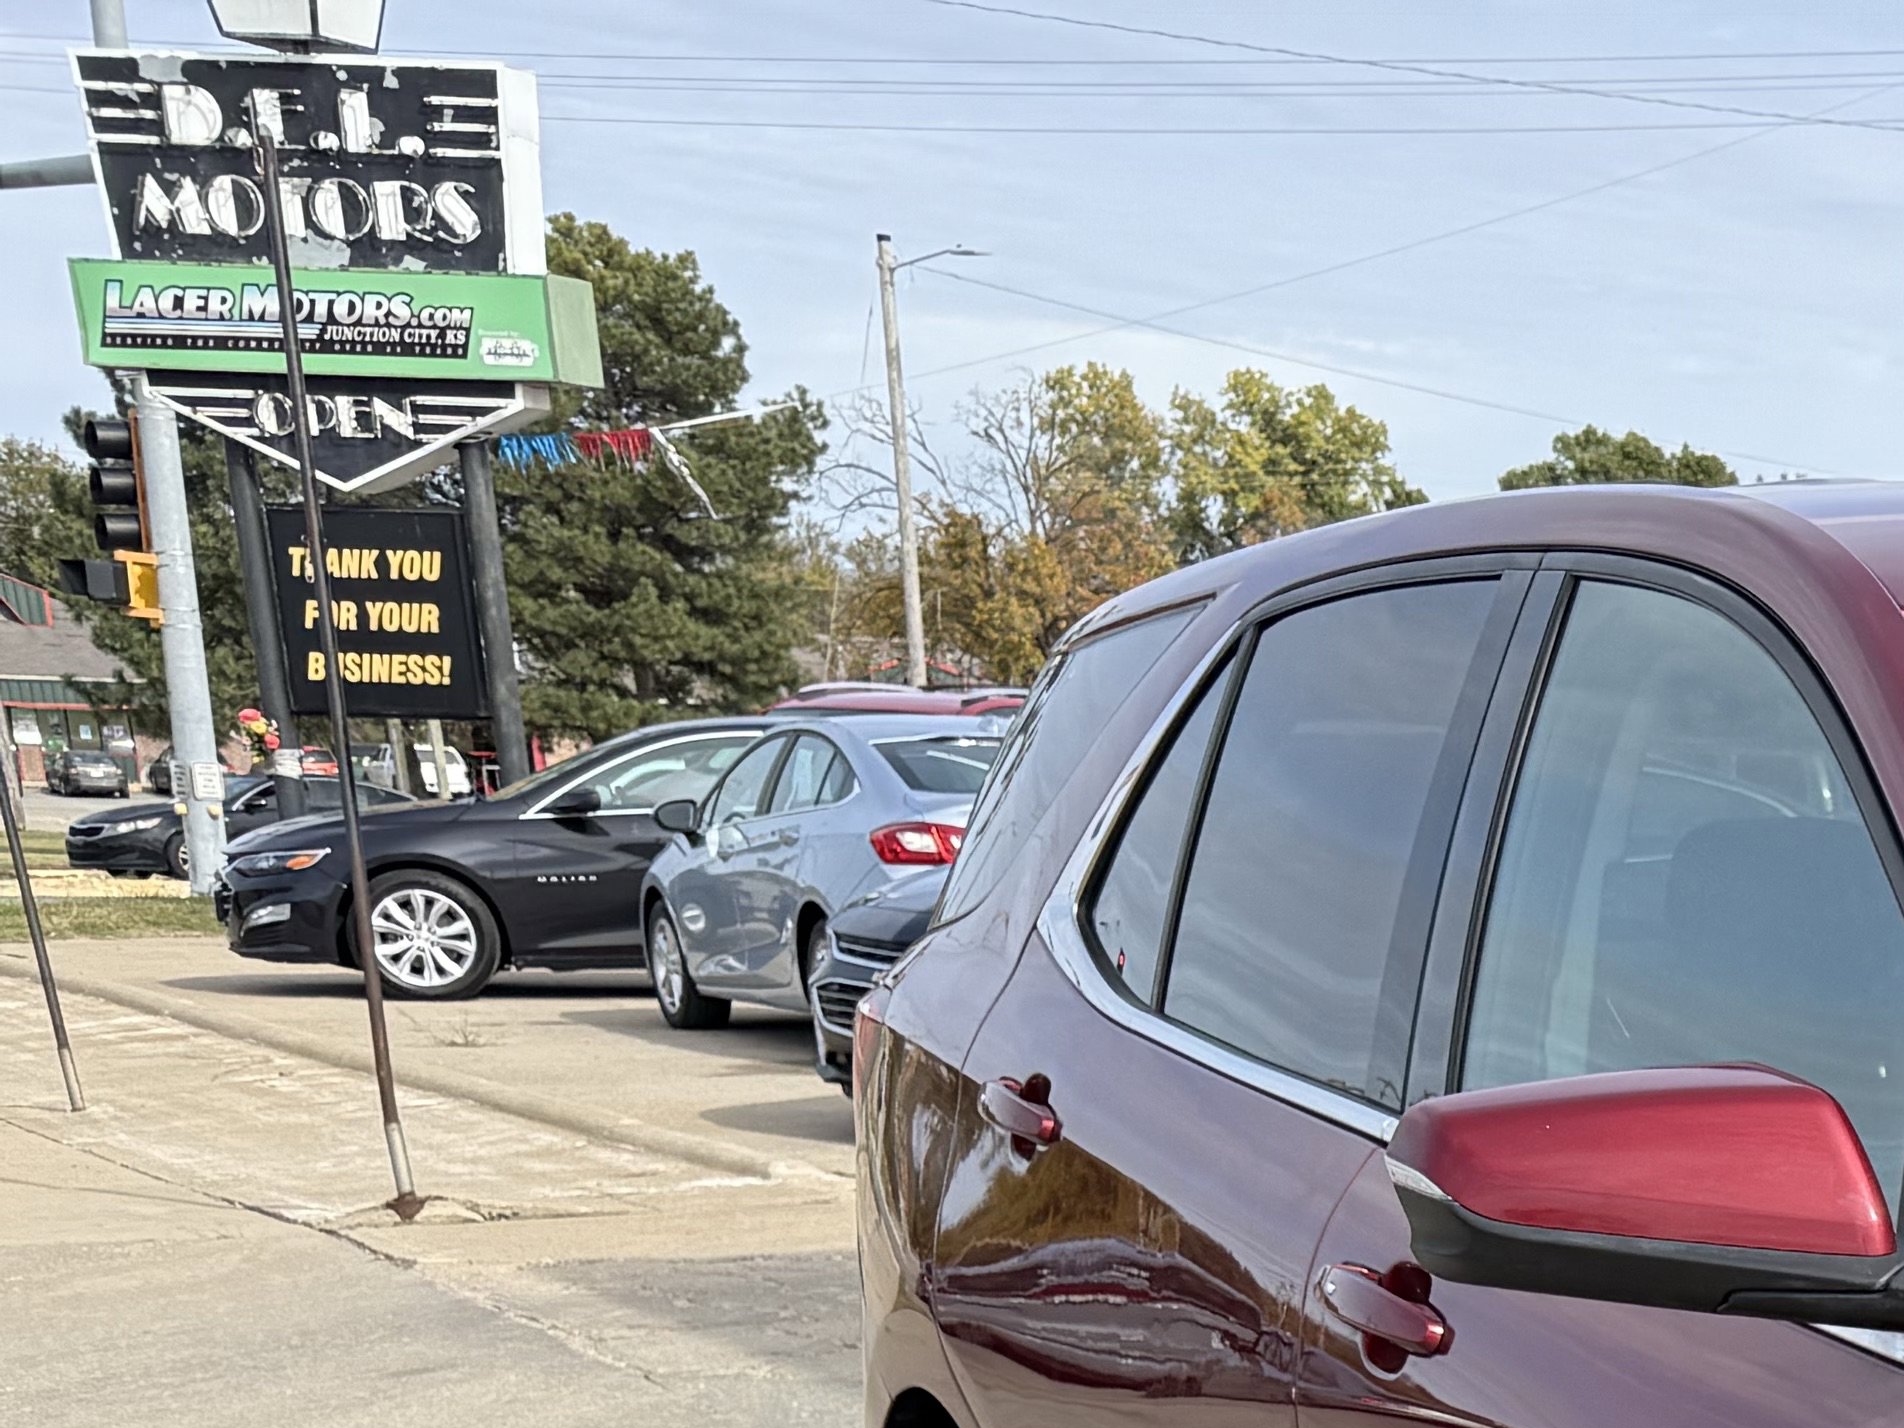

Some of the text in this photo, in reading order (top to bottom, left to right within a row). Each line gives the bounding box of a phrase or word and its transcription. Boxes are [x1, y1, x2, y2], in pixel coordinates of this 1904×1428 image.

[132, 172, 483, 246] MOTORS
[104, 278, 236, 321] LACER
[323, 324, 401, 344] JUNCTION
[403, 327, 443, 346] CITY,
[445, 329, 467, 346] KS
[253, 392, 415, 441] OPEN
[288, 546, 442, 583] TANK YOU
[304, 599, 440, 634] FR YOUR
